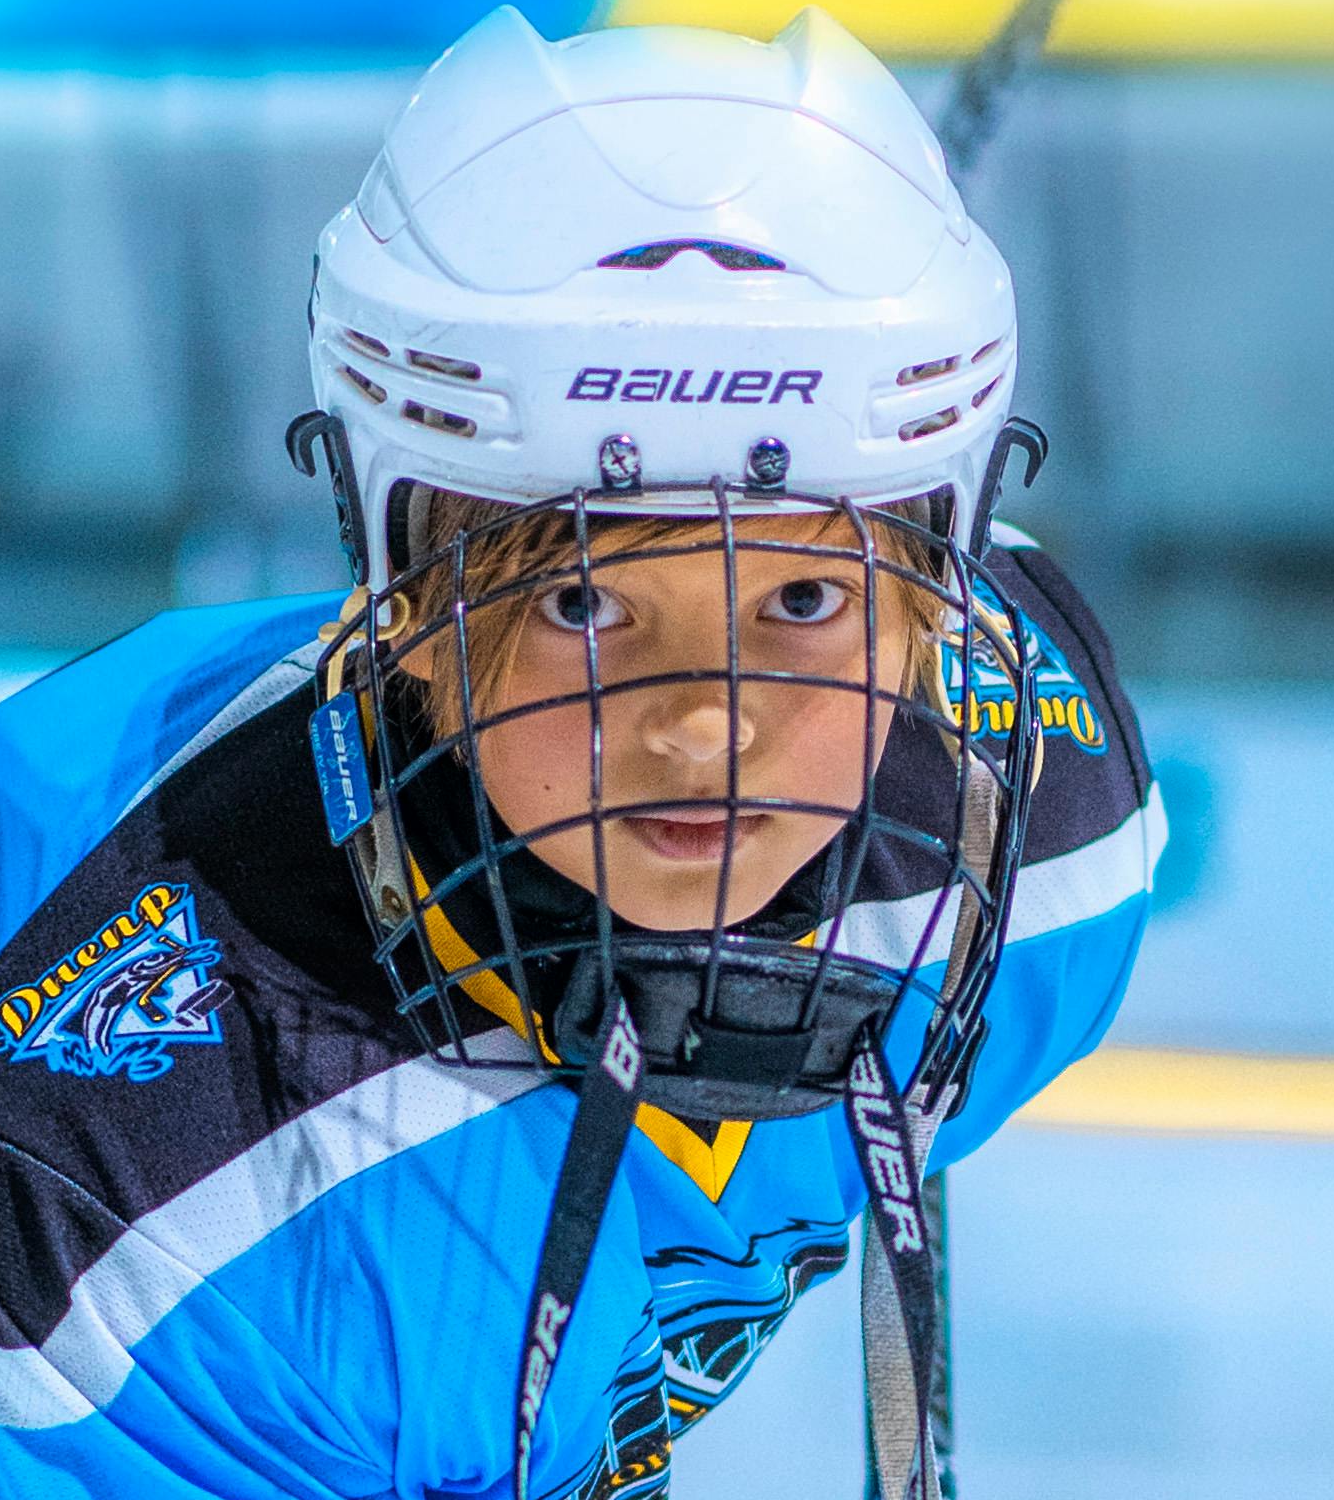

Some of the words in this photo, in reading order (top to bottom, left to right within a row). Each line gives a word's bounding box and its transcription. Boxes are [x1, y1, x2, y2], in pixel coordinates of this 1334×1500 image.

[566, 366, 824, 405] BAUER
[329, 709, 358, 821] BAUER
[849, 1050, 923, 1252] AUER
